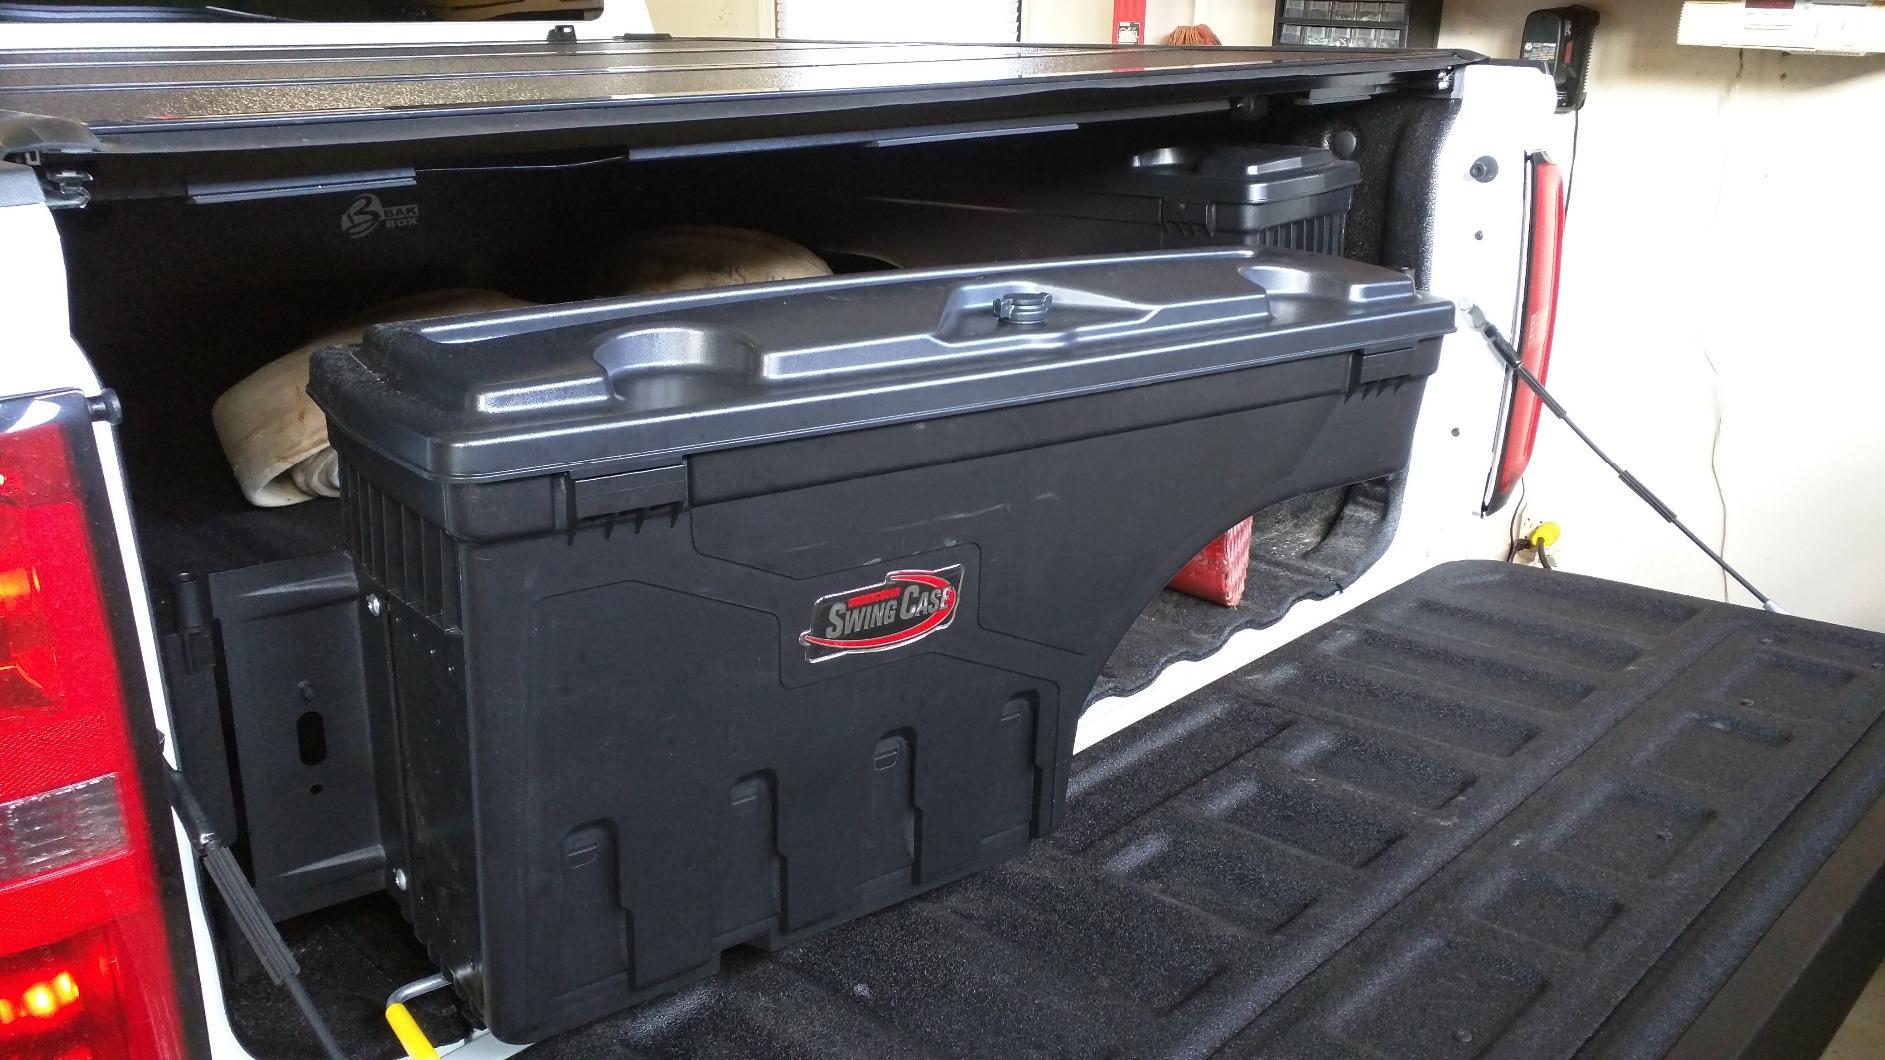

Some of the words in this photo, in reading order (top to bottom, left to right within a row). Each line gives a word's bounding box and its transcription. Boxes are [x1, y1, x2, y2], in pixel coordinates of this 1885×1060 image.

[384, 206, 417, 217] BAK
[386, 217, 418, 228] BOX
[825, 599, 898, 639] SWING
[900, 584, 952, 620] CASE
